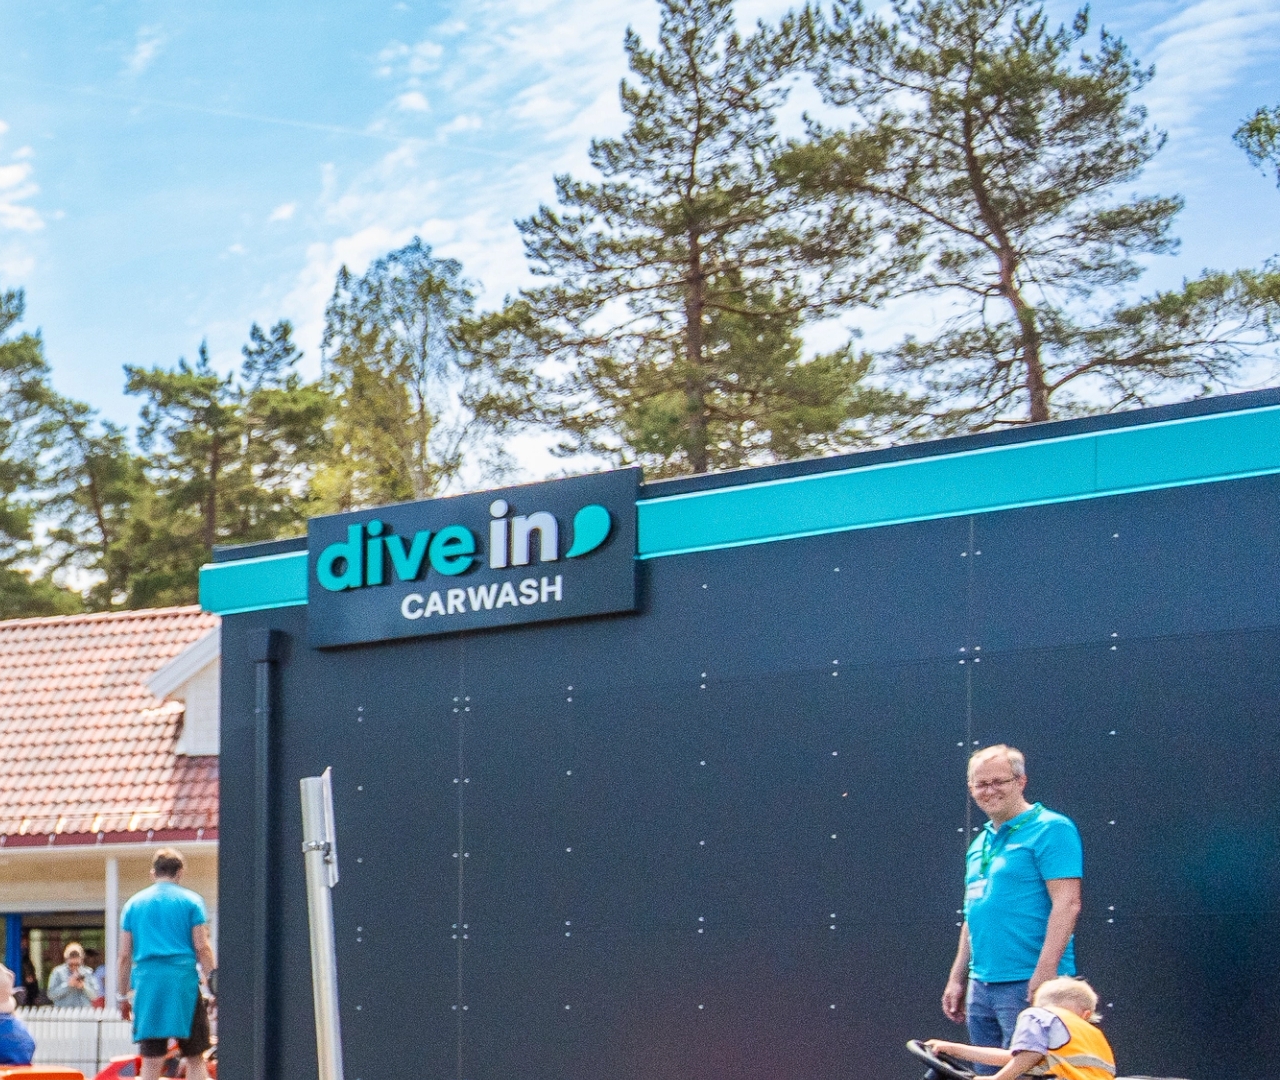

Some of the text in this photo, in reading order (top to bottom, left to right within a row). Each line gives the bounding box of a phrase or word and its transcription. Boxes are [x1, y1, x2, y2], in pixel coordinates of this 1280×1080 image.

[316, 499, 559, 592] dive in
[401, 575, 563, 620] CARWASH
